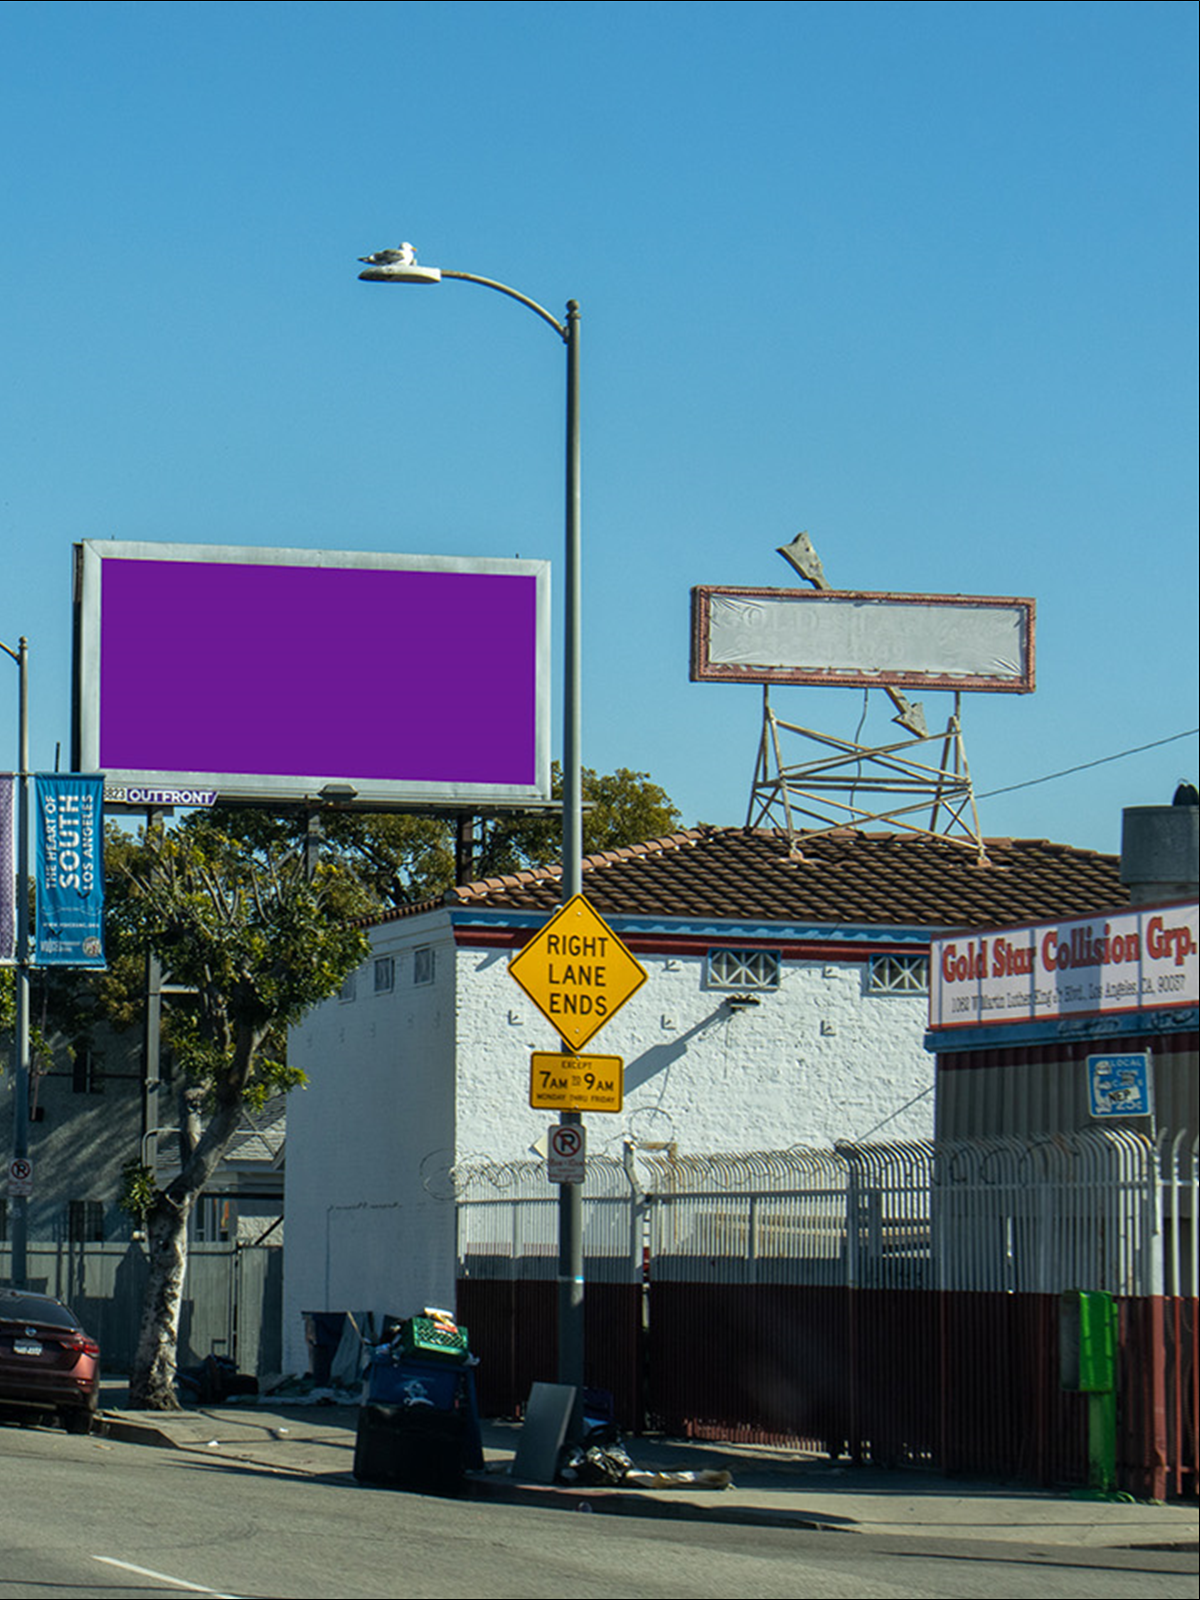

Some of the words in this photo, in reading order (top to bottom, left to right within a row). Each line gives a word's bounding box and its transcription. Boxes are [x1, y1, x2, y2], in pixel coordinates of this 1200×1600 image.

[45, 794, 58, 815] OF
[129, 789, 213, 805] OUTFRONT
[81, 794, 94, 859] ANGELES
[45, 817, 57, 861] HEART
[58, 794, 81, 890] SOUTH
[45, 864, 57, 890] THE
[81, 862, 94, 891] LOS
[547, 934, 608, 957] RIGHT
[942, 941, 988, 983] Gold
[992, 937, 1036, 977] Star
[1042, 922, 1141, 973] Collision
[1146, 915, 1198, 967] Grp.
[549, 963, 606, 987] LANE
[549, 993, 608, 1017] ENDS
[561, 1060, 593, 1070] EXCEPT
[1110, 1058, 1142, 1068] LOCAL
[537, 1093, 566, 1101] MONDAY
[569, 1094, 588, 1103] THRU
[591, 1095, 615, 1104] FRIDAY
